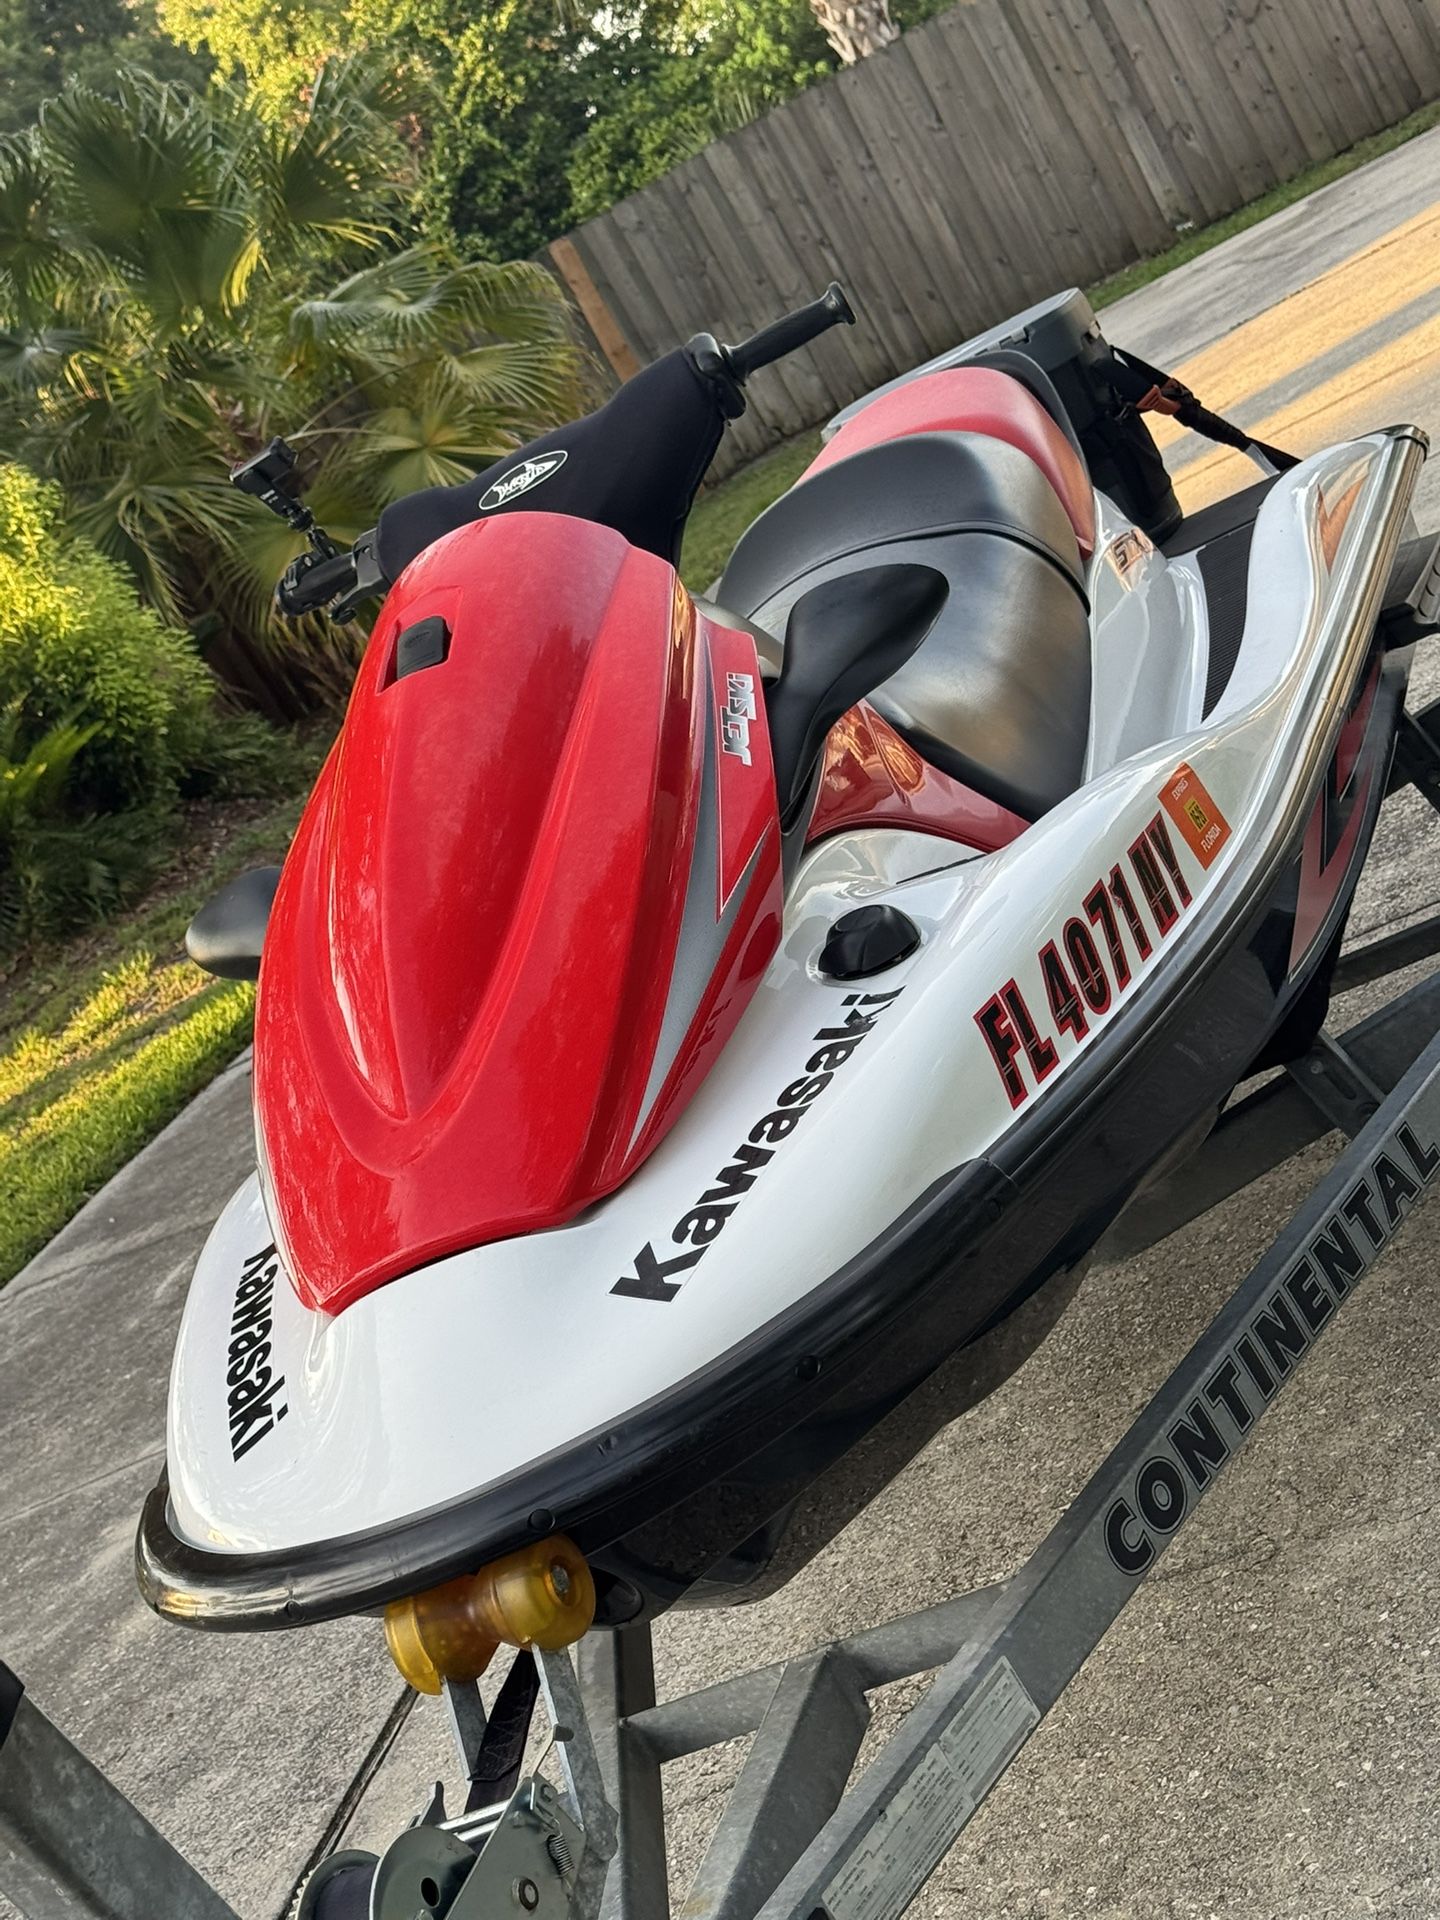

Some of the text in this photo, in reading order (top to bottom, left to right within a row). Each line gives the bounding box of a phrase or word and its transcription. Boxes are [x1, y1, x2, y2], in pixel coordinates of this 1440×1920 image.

[1200, 822, 1222, 853] FLORIDA
[973, 978, 1060, 1111] FL
[1038, 863, 1153, 1044] 4071
[608, 985, 907, 1302] Kawasaki
[226, 1243, 289, 1463] Kawasaki
[1104, 1121, 1440, 1576] CONTINENTAL
